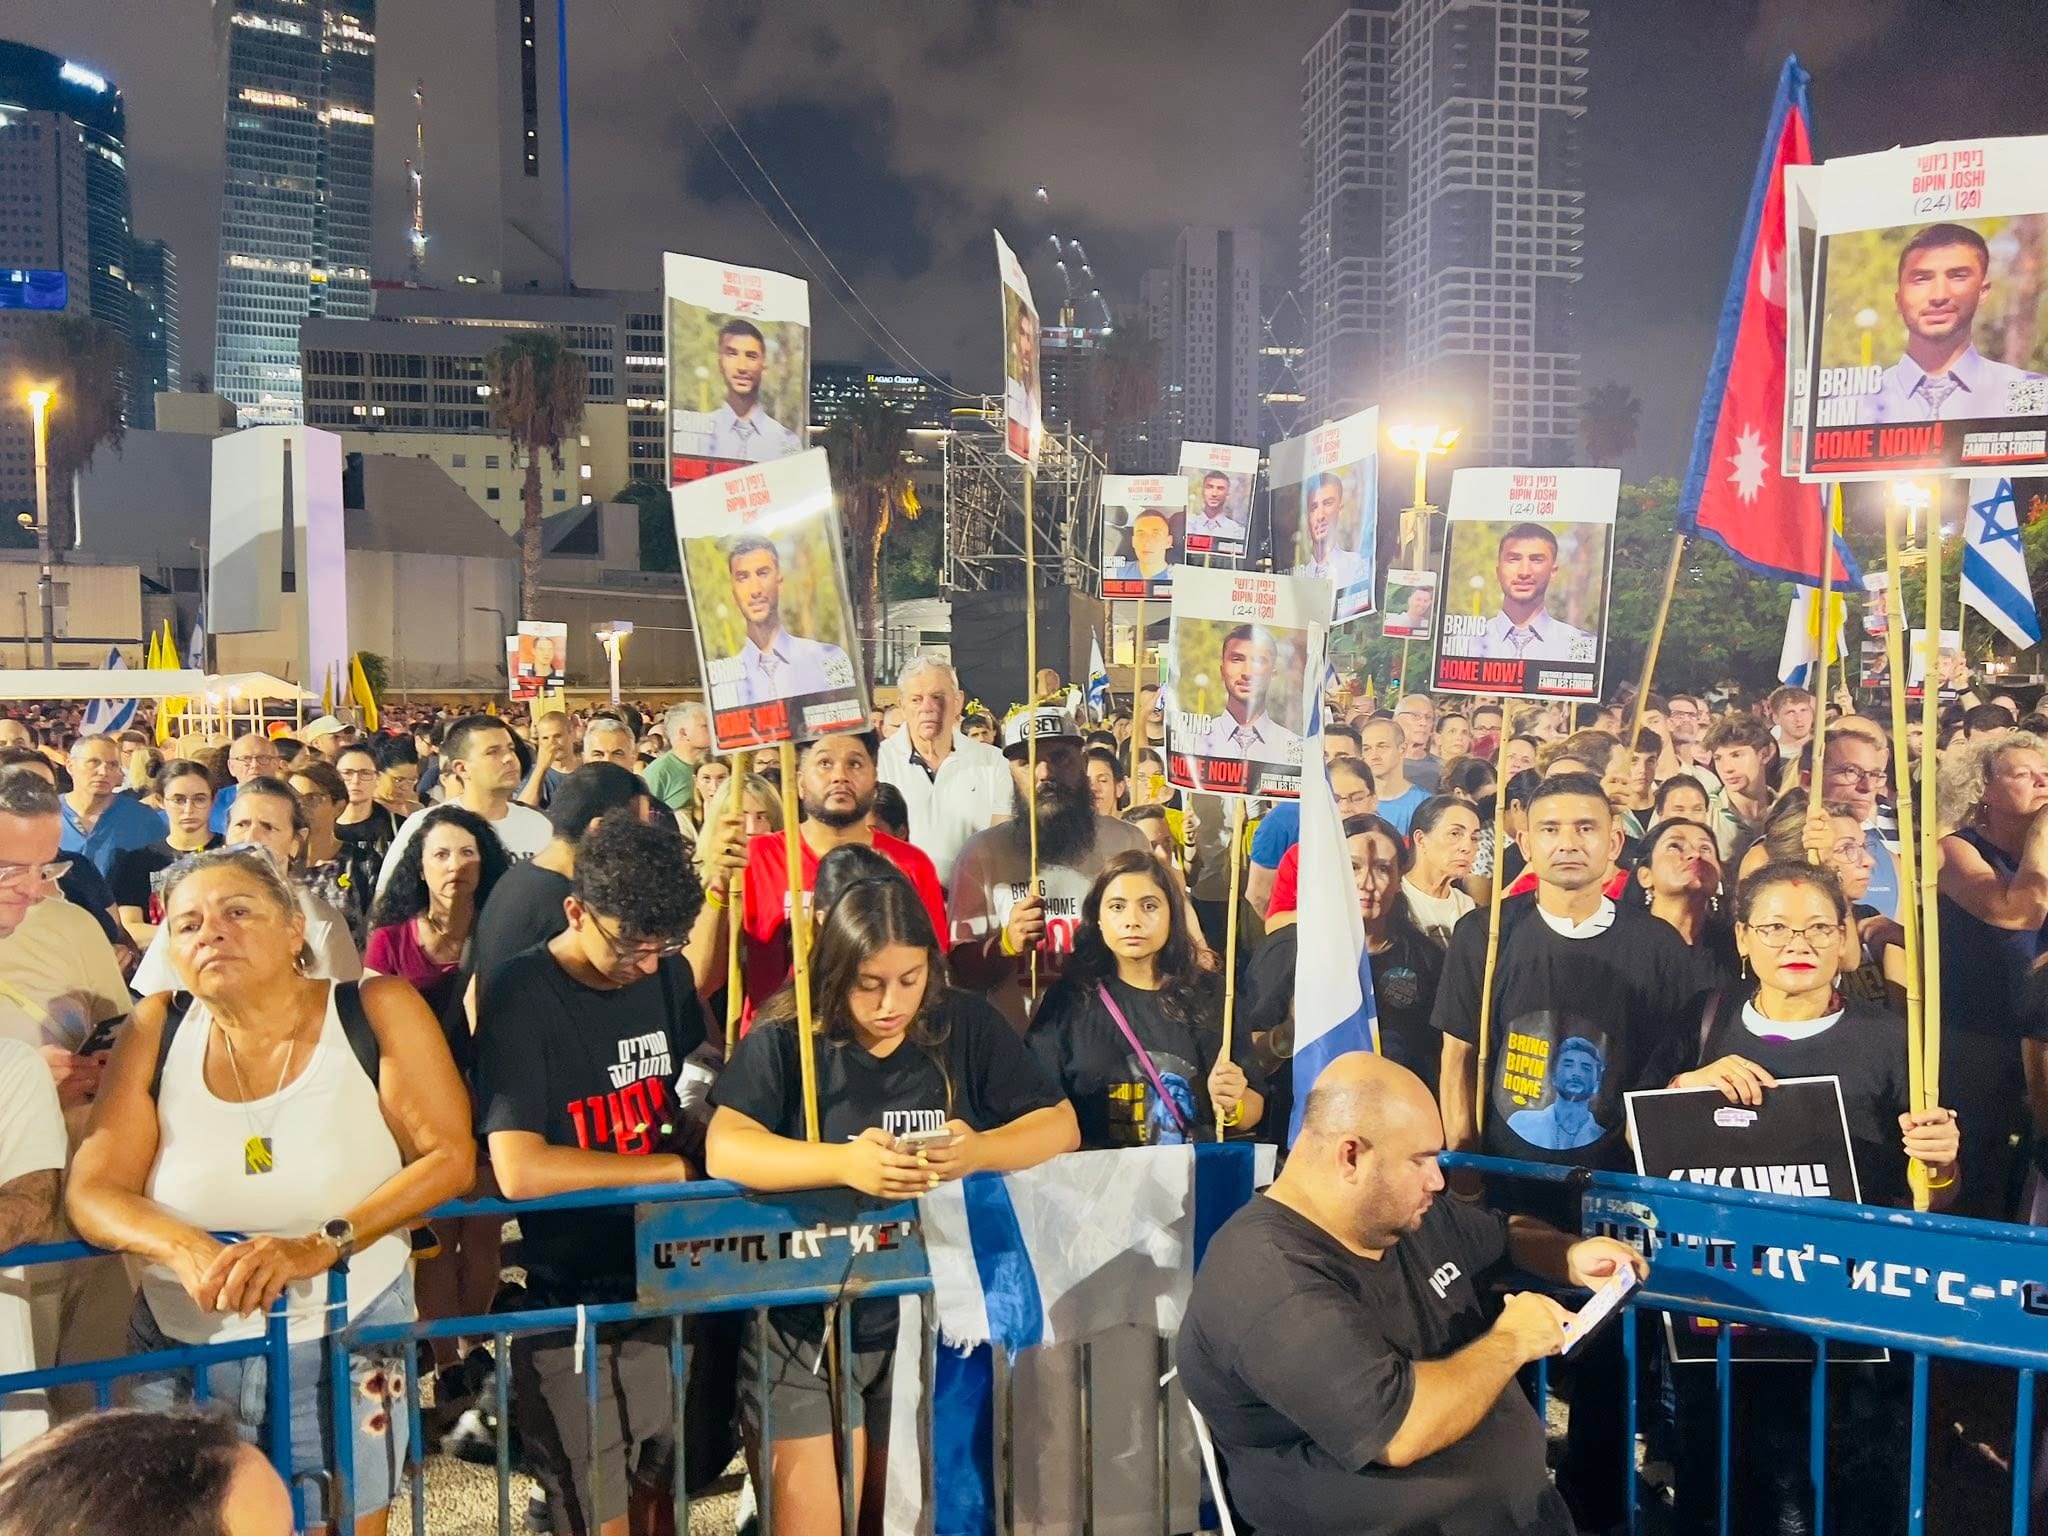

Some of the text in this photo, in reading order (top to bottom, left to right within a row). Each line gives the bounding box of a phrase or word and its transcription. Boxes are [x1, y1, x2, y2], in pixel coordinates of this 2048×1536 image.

[1912, 170, 1985, 193] BIPIN JOSHI
[1914, 194, 1951, 216] (24)
[1818, 365, 1883, 397] BRING
[1816, 399, 1857, 427] HIM
[1815, 422, 1944, 460] HOME NOW!
[1962, 440, 2045, 456] FAMILIES FORUM
[1509, 488, 1557, 501] BIPIN JOSHI
[1509, 503, 1535, 515] (24)
[1232, 590, 1277, 606] BIPIN JOSHI
[1444, 615, 1487, 637] BRING
[1442, 635, 1471, 657] HIM
[1440, 660, 1526, 684] HOME NOW!
[1568, 680, 1594, 689] FORUM
[1023, 718, 1057, 736] OBEY
[1208, 760, 1249, 784] NOW!
[1011, 880, 1046, 900] BRG
[1044, 897, 1076, 915] HOME
[1508, 1032, 1549, 1058] BRING
[1506, 1052, 1546, 1079] BIPIN
[1503, 1072, 1542, 1099] HOME
